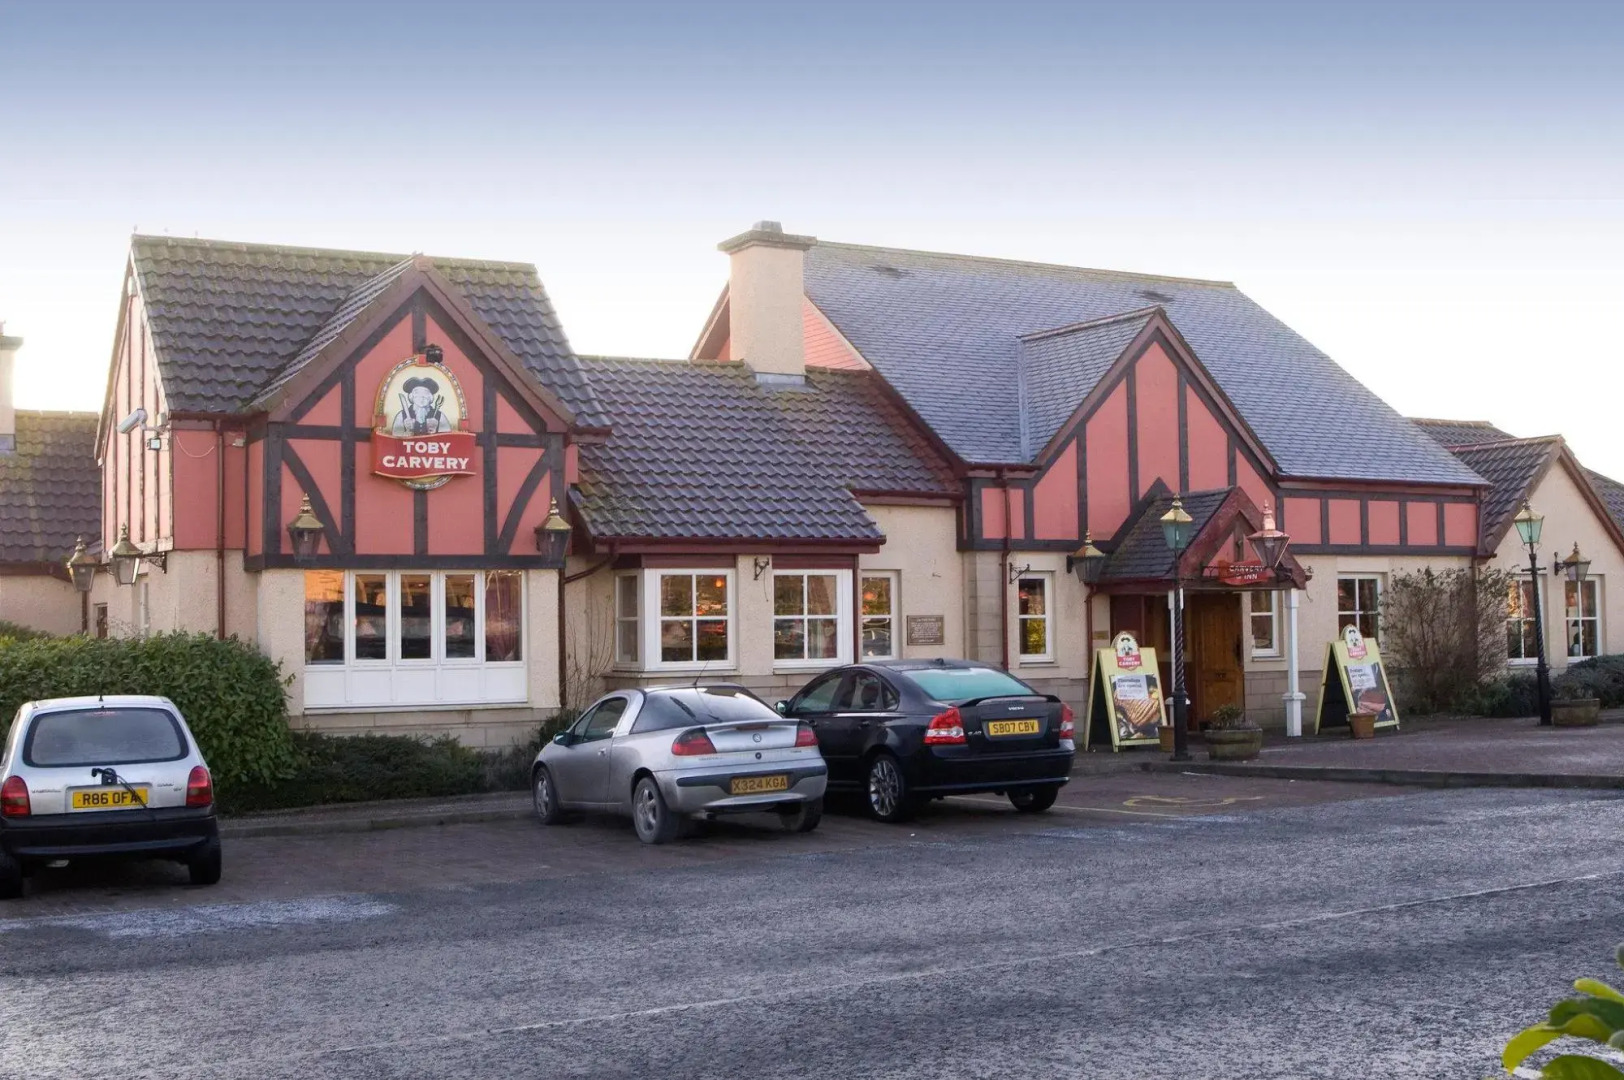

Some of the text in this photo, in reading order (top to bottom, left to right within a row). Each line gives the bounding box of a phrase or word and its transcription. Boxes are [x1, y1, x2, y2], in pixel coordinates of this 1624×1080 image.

[402, 441, 451, 454] TOBY
[382, 455, 470, 470] CARVERY
[992, 722, 1016, 734] SB07
[1018, 720, 1036, 732] CBV
[732, 777, 787, 792] X324 KGA
[82, 792, 109, 806] R86
